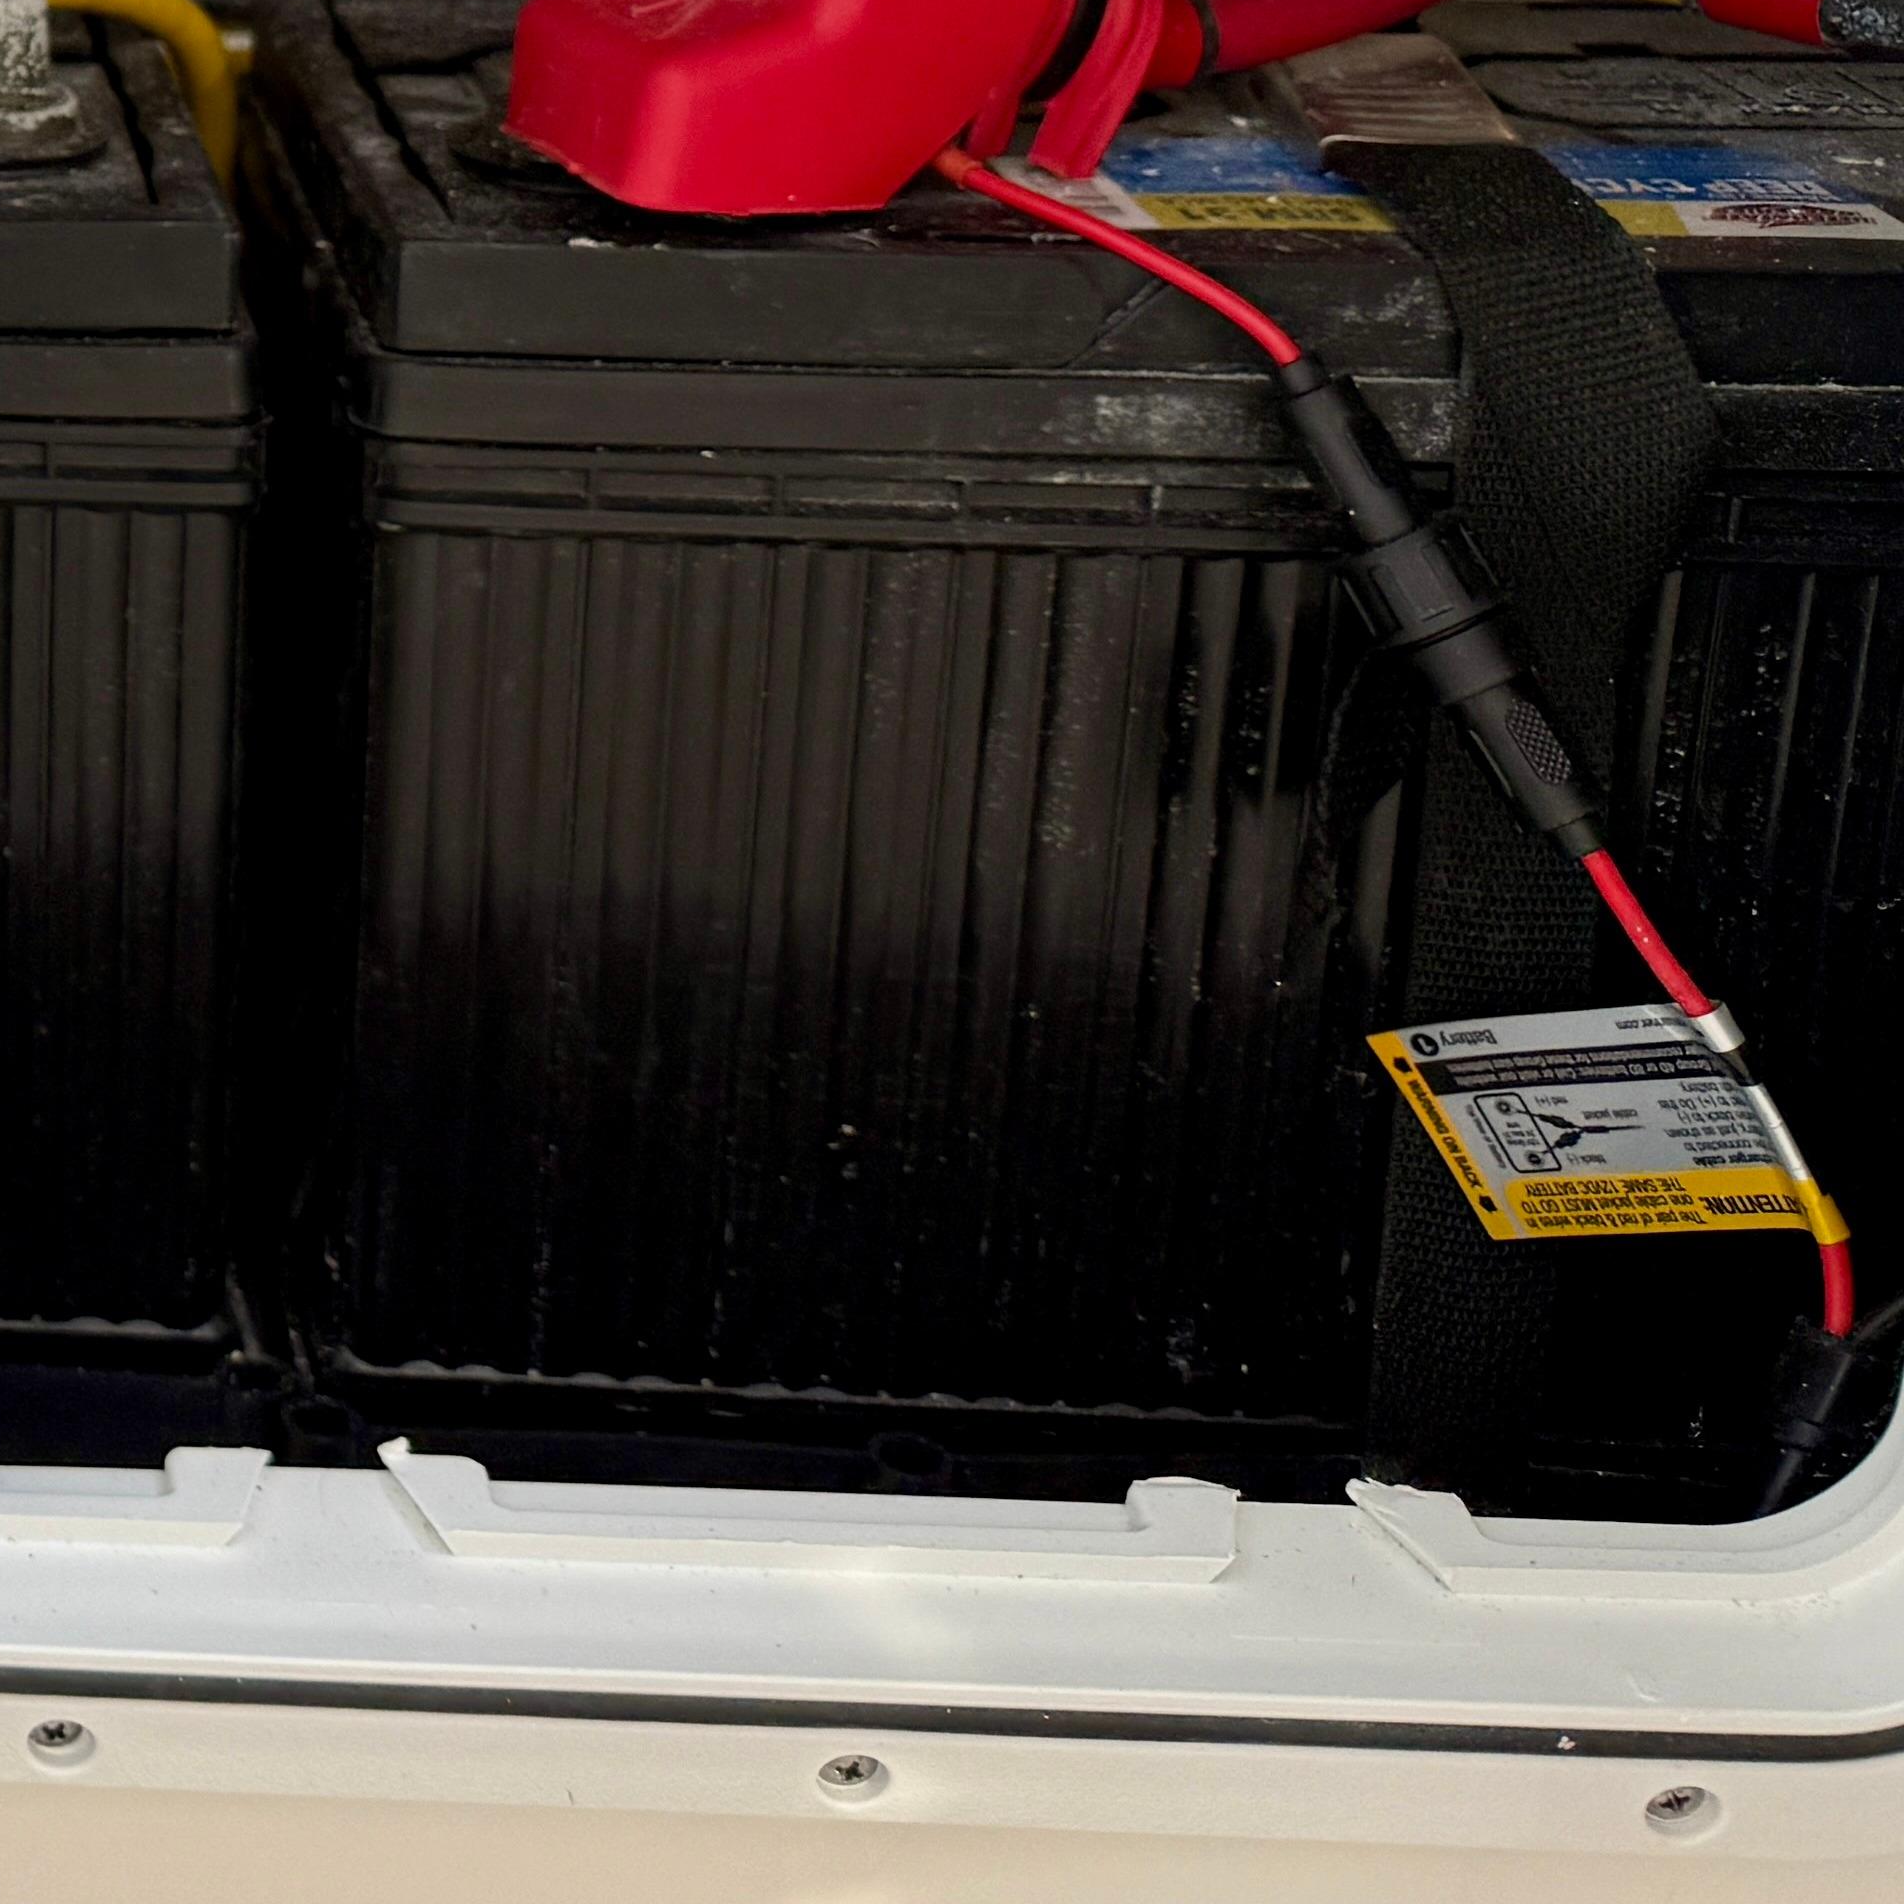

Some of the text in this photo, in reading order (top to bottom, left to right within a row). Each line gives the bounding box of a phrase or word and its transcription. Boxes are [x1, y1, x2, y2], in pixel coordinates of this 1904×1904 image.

[1572, 177, 1697, 195] CYC
[1439, 1028, 1498, 1047] Battery
[1407, 1079, 1484, 1189] WARNING ON BACK
[1524, 1181, 1577, 1197] BATTERY
[1622, 1178, 1657, 1194] SAME
[1655, 1176, 1688, 1192] THE
[1521, 1193, 1695, 1214] one cable jacket MUST GO TO
[1575, 1214, 1606, 1228] black
[1618, 1213, 1639, 1226] red
[1680, 1210, 1708, 1225] The
